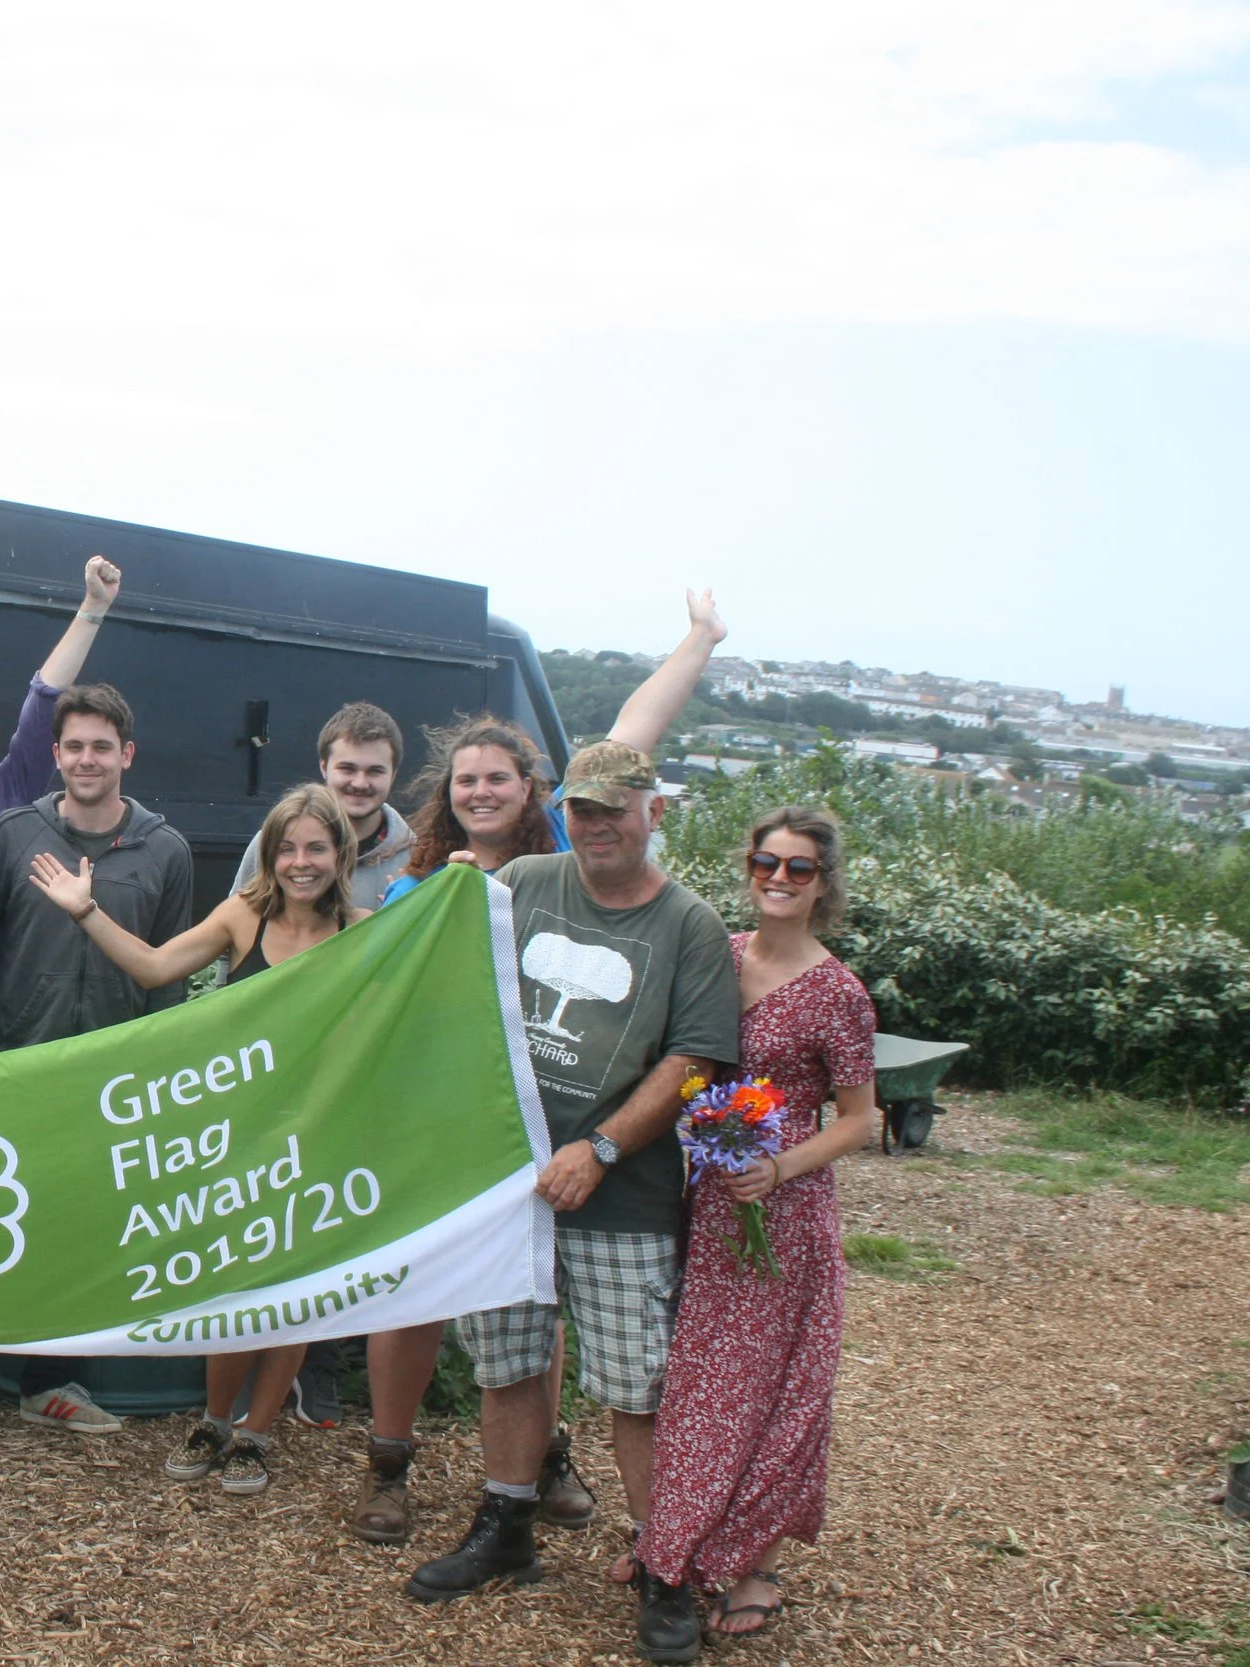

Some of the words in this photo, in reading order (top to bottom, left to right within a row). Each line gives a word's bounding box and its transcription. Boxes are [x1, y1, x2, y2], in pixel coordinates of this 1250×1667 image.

[99, 1038, 275, 1126] Green
[528, 1040, 578, 1065] CHARD
[110, 1118, 231, 1191] Flag
[118, 1133, 303, 1247] Award
[125, 1167, 381, 1301] 2019/20
